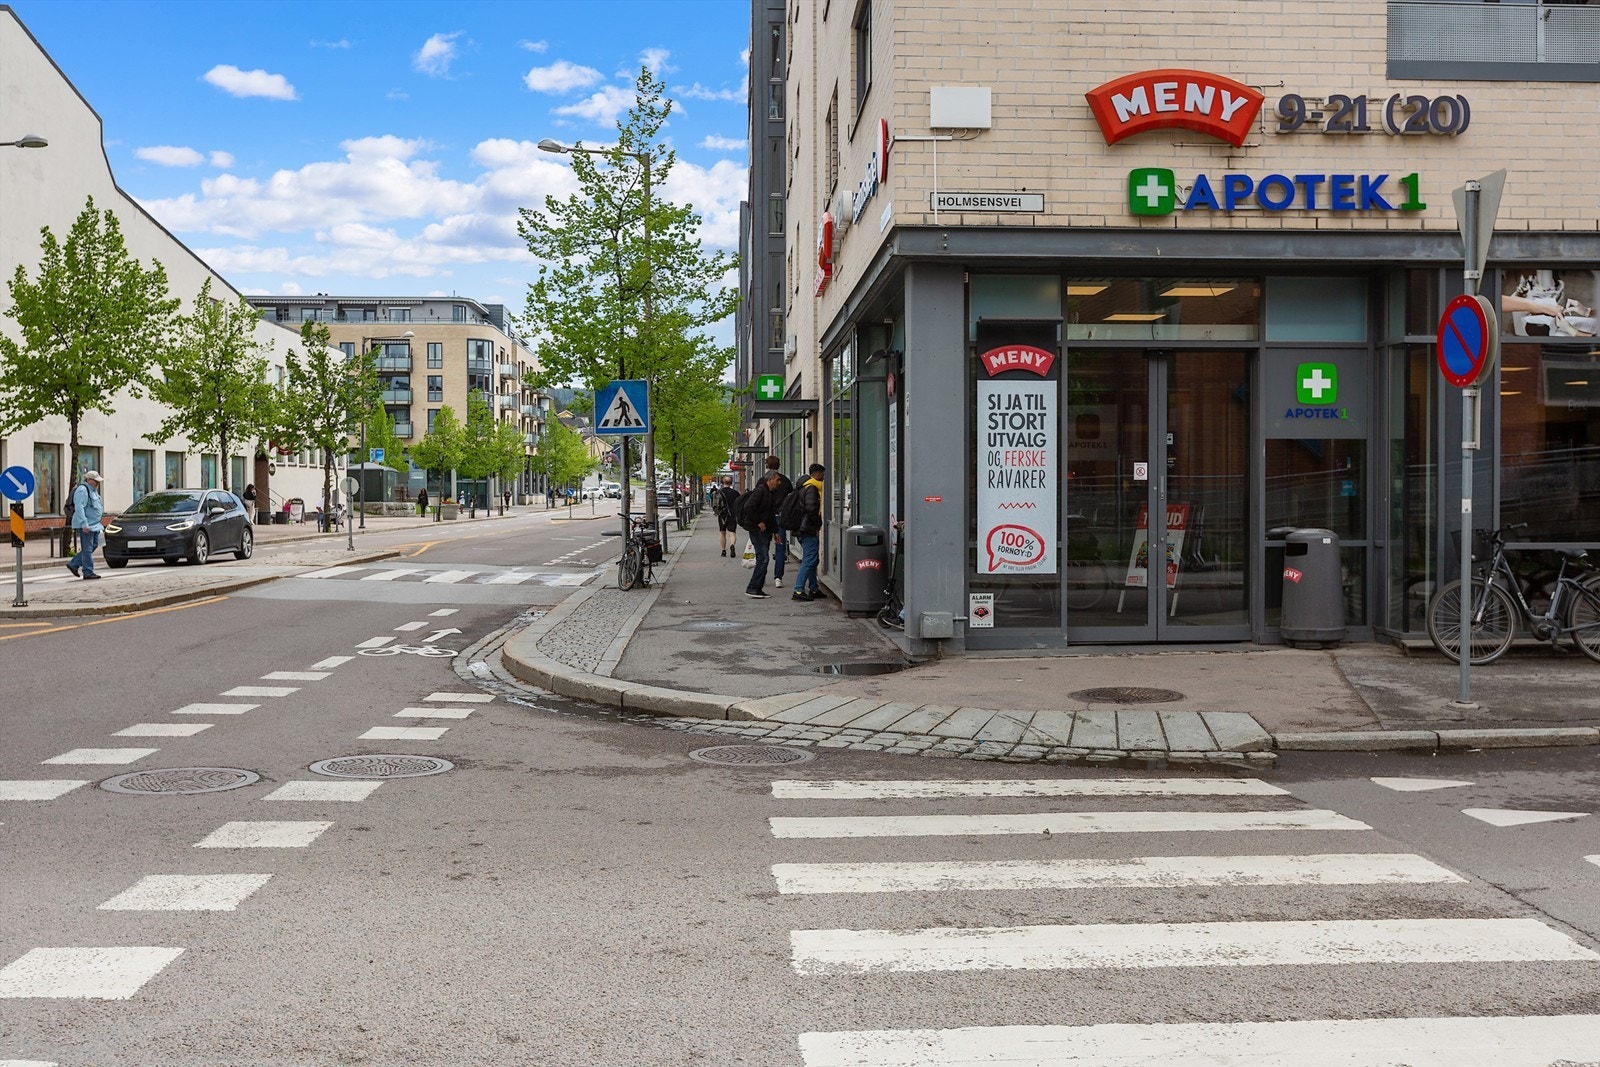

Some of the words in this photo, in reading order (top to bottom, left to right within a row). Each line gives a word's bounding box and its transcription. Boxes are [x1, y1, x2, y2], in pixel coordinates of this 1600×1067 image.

[1111, 82, 1249, 122] MENY
[1275, 93, 1371, 134] 9-21
[1382, 93, 1471, 136] (20)
[1184, 174, 1392, 212] APOTEK
[1400, 173, 1427, 211] 1
[938, 197, 1022, 207] HOLMSENSVEI
[990, 350, 1047, 368] MENY
[988, 394, 1001, 411] SI
[1004, 394, 1023, 411] JA
[1025, 394, 1046, 411] TIL
[988, 412, 1047, 430] STORT
[1285, 408, 1339, 419] APOTEK
[1341, 407, 1348, 419] 1
[988, 432, 1047, 448] UTVALG
[1068, 441, 1102, 449] APOTEK
[988, 451, 1001, 467] OG
[1004, 450, 1046, 467] FERSKE
[988, 465, 1046, 489] RÅVARER
[1001, 531, 1034, 551] 100%
